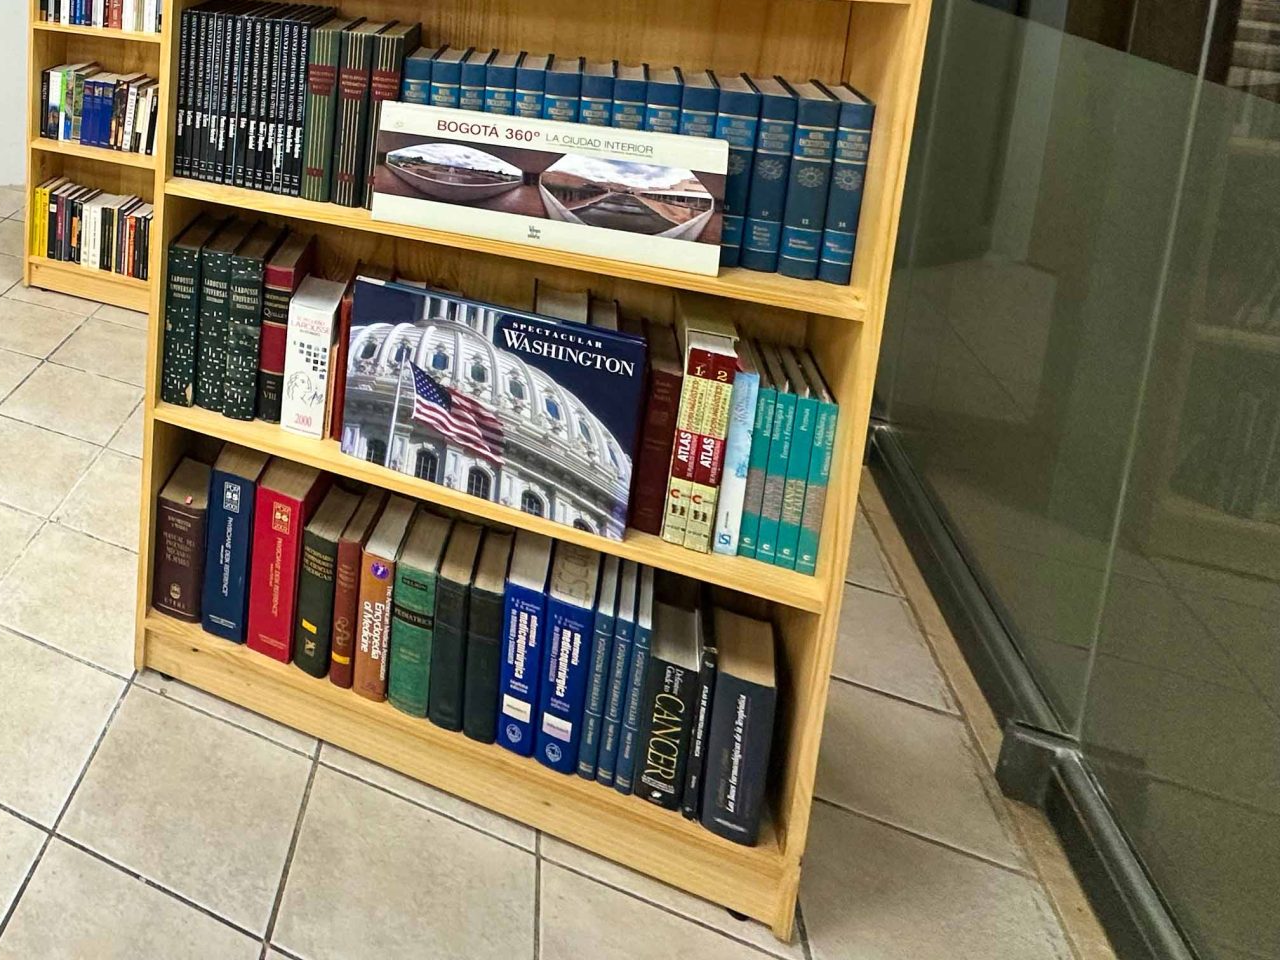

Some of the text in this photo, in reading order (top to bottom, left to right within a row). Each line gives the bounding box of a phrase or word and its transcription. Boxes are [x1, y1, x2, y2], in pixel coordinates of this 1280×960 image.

[437, 119, 499, 139] BOGOTÁ
[546, 133, 560, 144] LA
[562, 134, 602, 148] CIUDAD
[604, 139, 654, 156] INTERIOR
[512, 322, 603, 349] SPECTACULAR
[502, 328, 636, 377] WASHINGTON
[716, 370, 729, 382] 2
[677, 432, 692, 462] ATLAS
[700, 438, 715, 468] ATLAS
[361, 612, 370, 652] Medicine
[371, 603, 384, 659] Encyclopedia
[664, 666, 674, 683] Guide
[645, 694, 685, 780] CANCER
